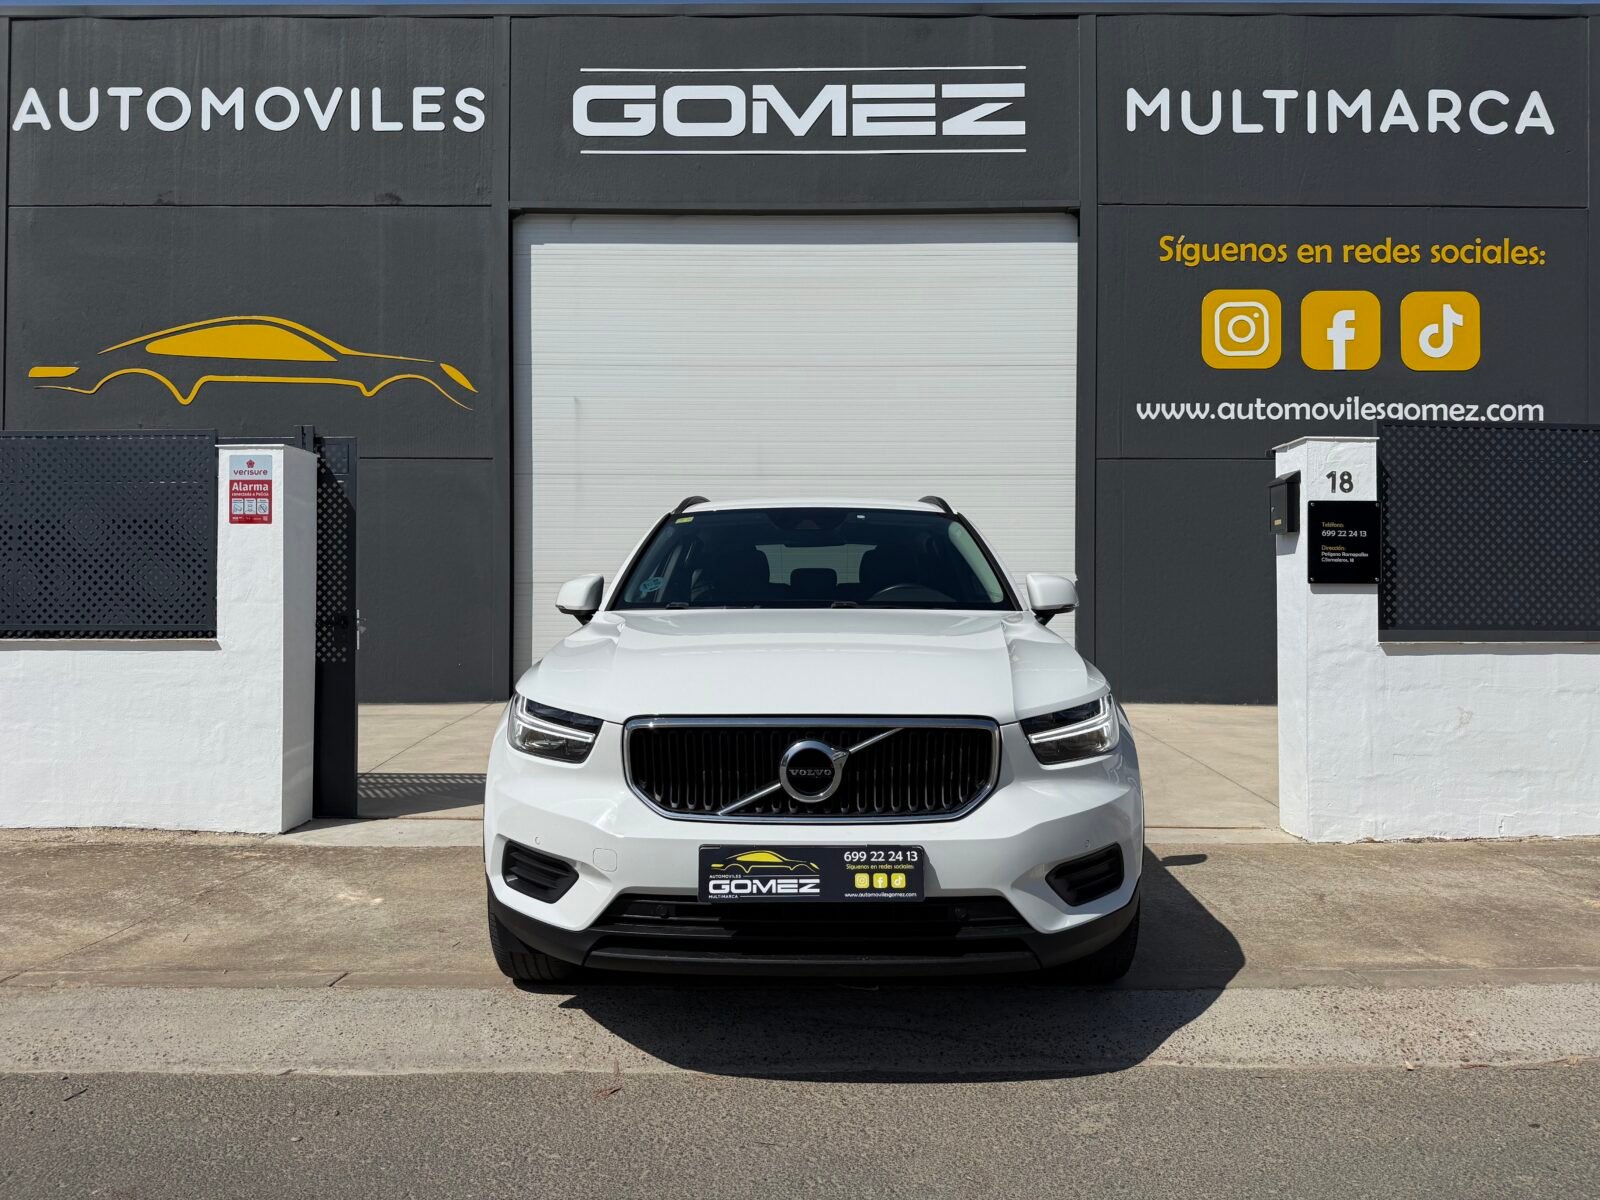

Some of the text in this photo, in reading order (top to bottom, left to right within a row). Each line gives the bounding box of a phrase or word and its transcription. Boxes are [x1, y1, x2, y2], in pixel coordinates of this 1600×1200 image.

[12, 86, 486, 133] AUTOMOVILES
[573, 83, 1026, 137] GOMEZ
[1126, 88, 1555, 135] MULTIMARCA
[1159, 236, 1547, 267] Síguenos en redes sociales:
[232, 481, 269, 491] Alarma
[1325, 470, 1354, 494] 18
[1321, 529, 1336, 537] 699
[843, 851, 918, 862] 699 22 24 13
[708, 879, 820, 894] GOMEZ
